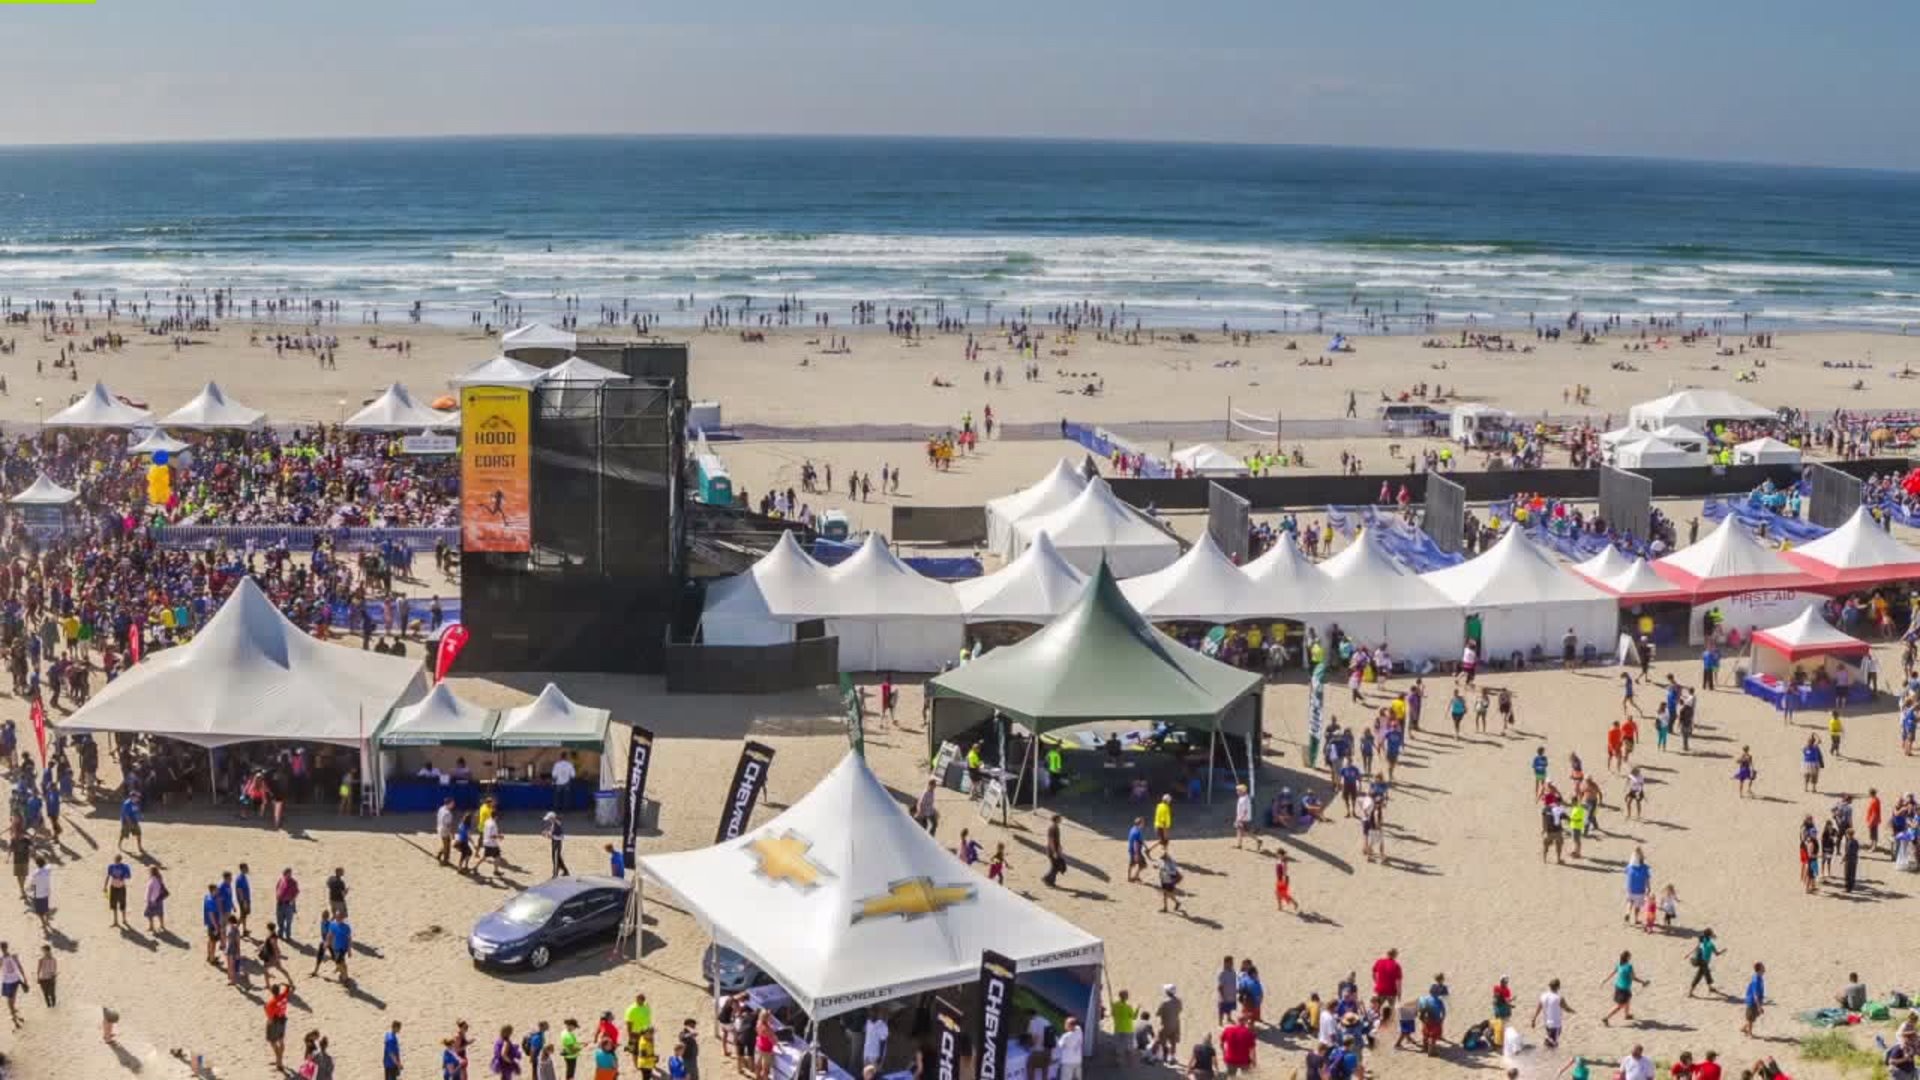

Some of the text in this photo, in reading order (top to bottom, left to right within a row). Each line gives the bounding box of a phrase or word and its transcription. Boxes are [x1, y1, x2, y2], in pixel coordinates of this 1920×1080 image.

[475, 432, 516, 444] HOOD
[475, 455, 516, 468] COAST
[1775, 589, 1796, 601] AID
[1030, 946, 1096, 967] CHEVROLET
[821, 987, 892, 1008] CHEVROLET
[980, 978, 1005, 1080] CHEVRO
